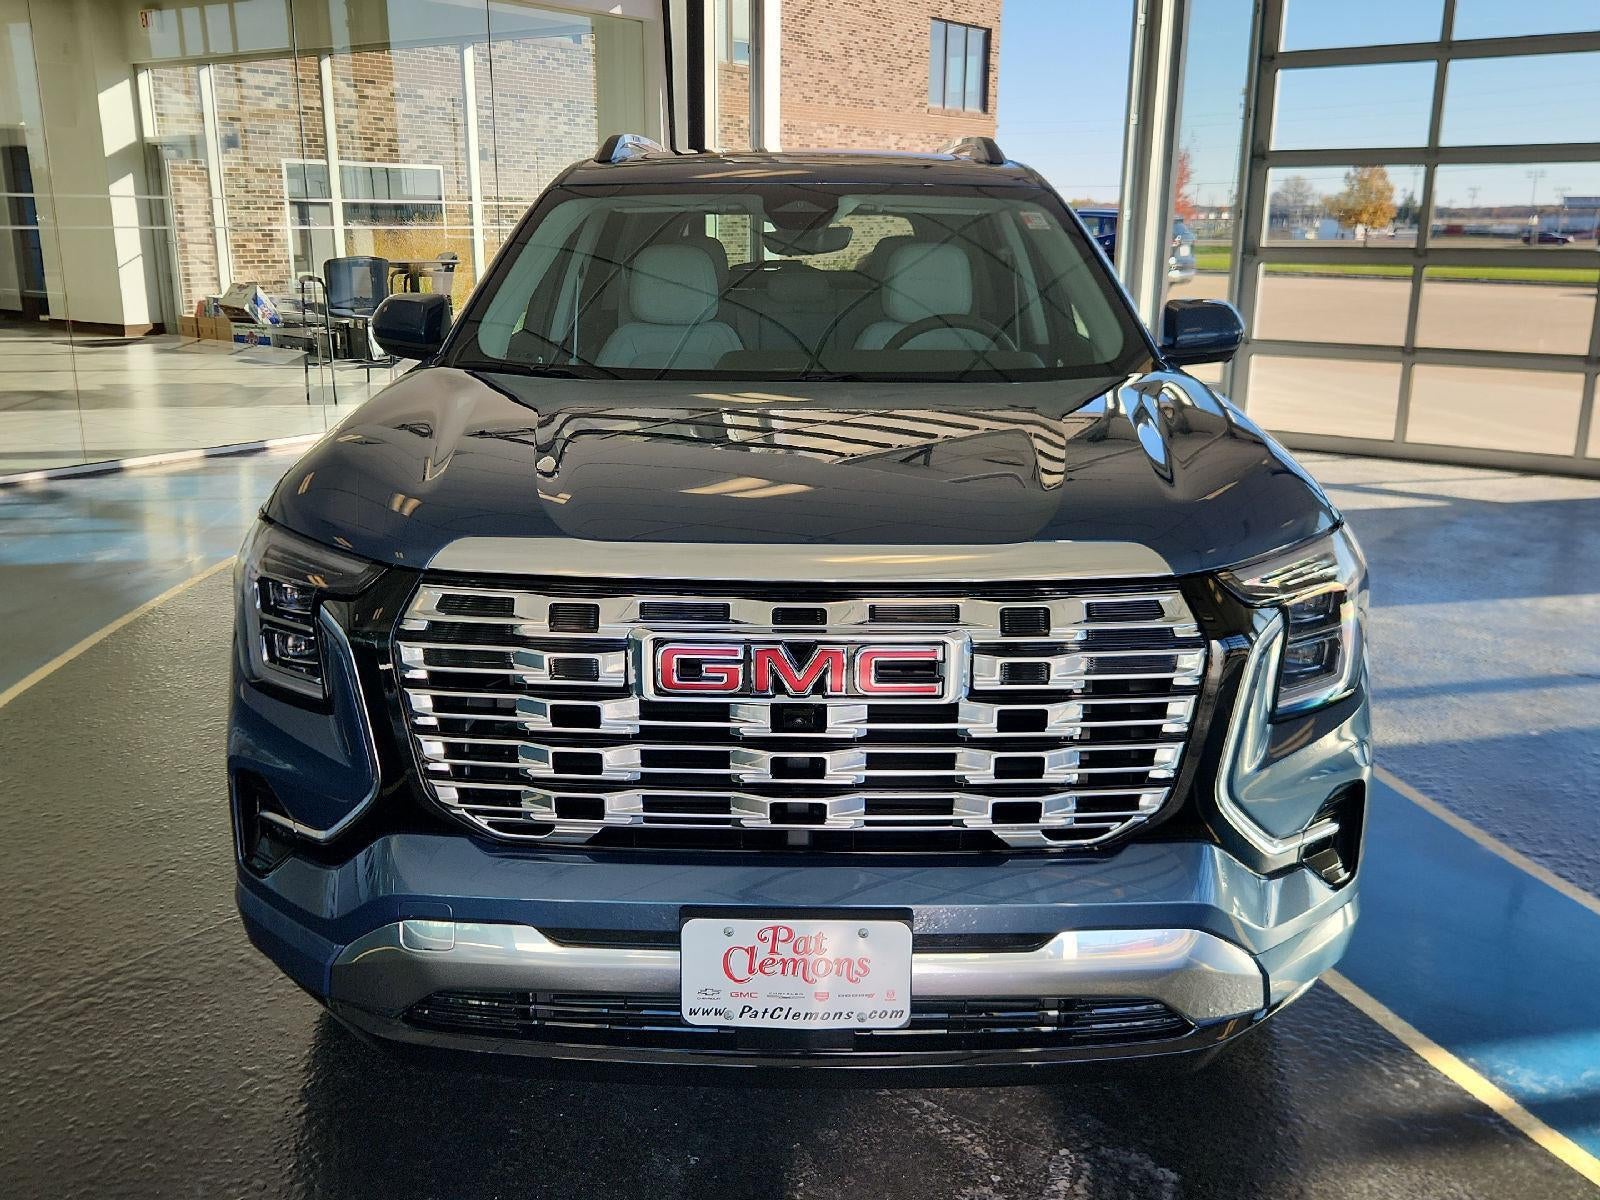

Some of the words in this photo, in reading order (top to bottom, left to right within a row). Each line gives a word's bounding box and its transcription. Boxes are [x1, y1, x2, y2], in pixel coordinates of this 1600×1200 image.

[655, 642, 945, 697] GMC
[757, 925, 828, 956] Pat
[722, 945, 871, 984] Clemons
[688, 1005, 905, 1021] wwwPatClemonscom
